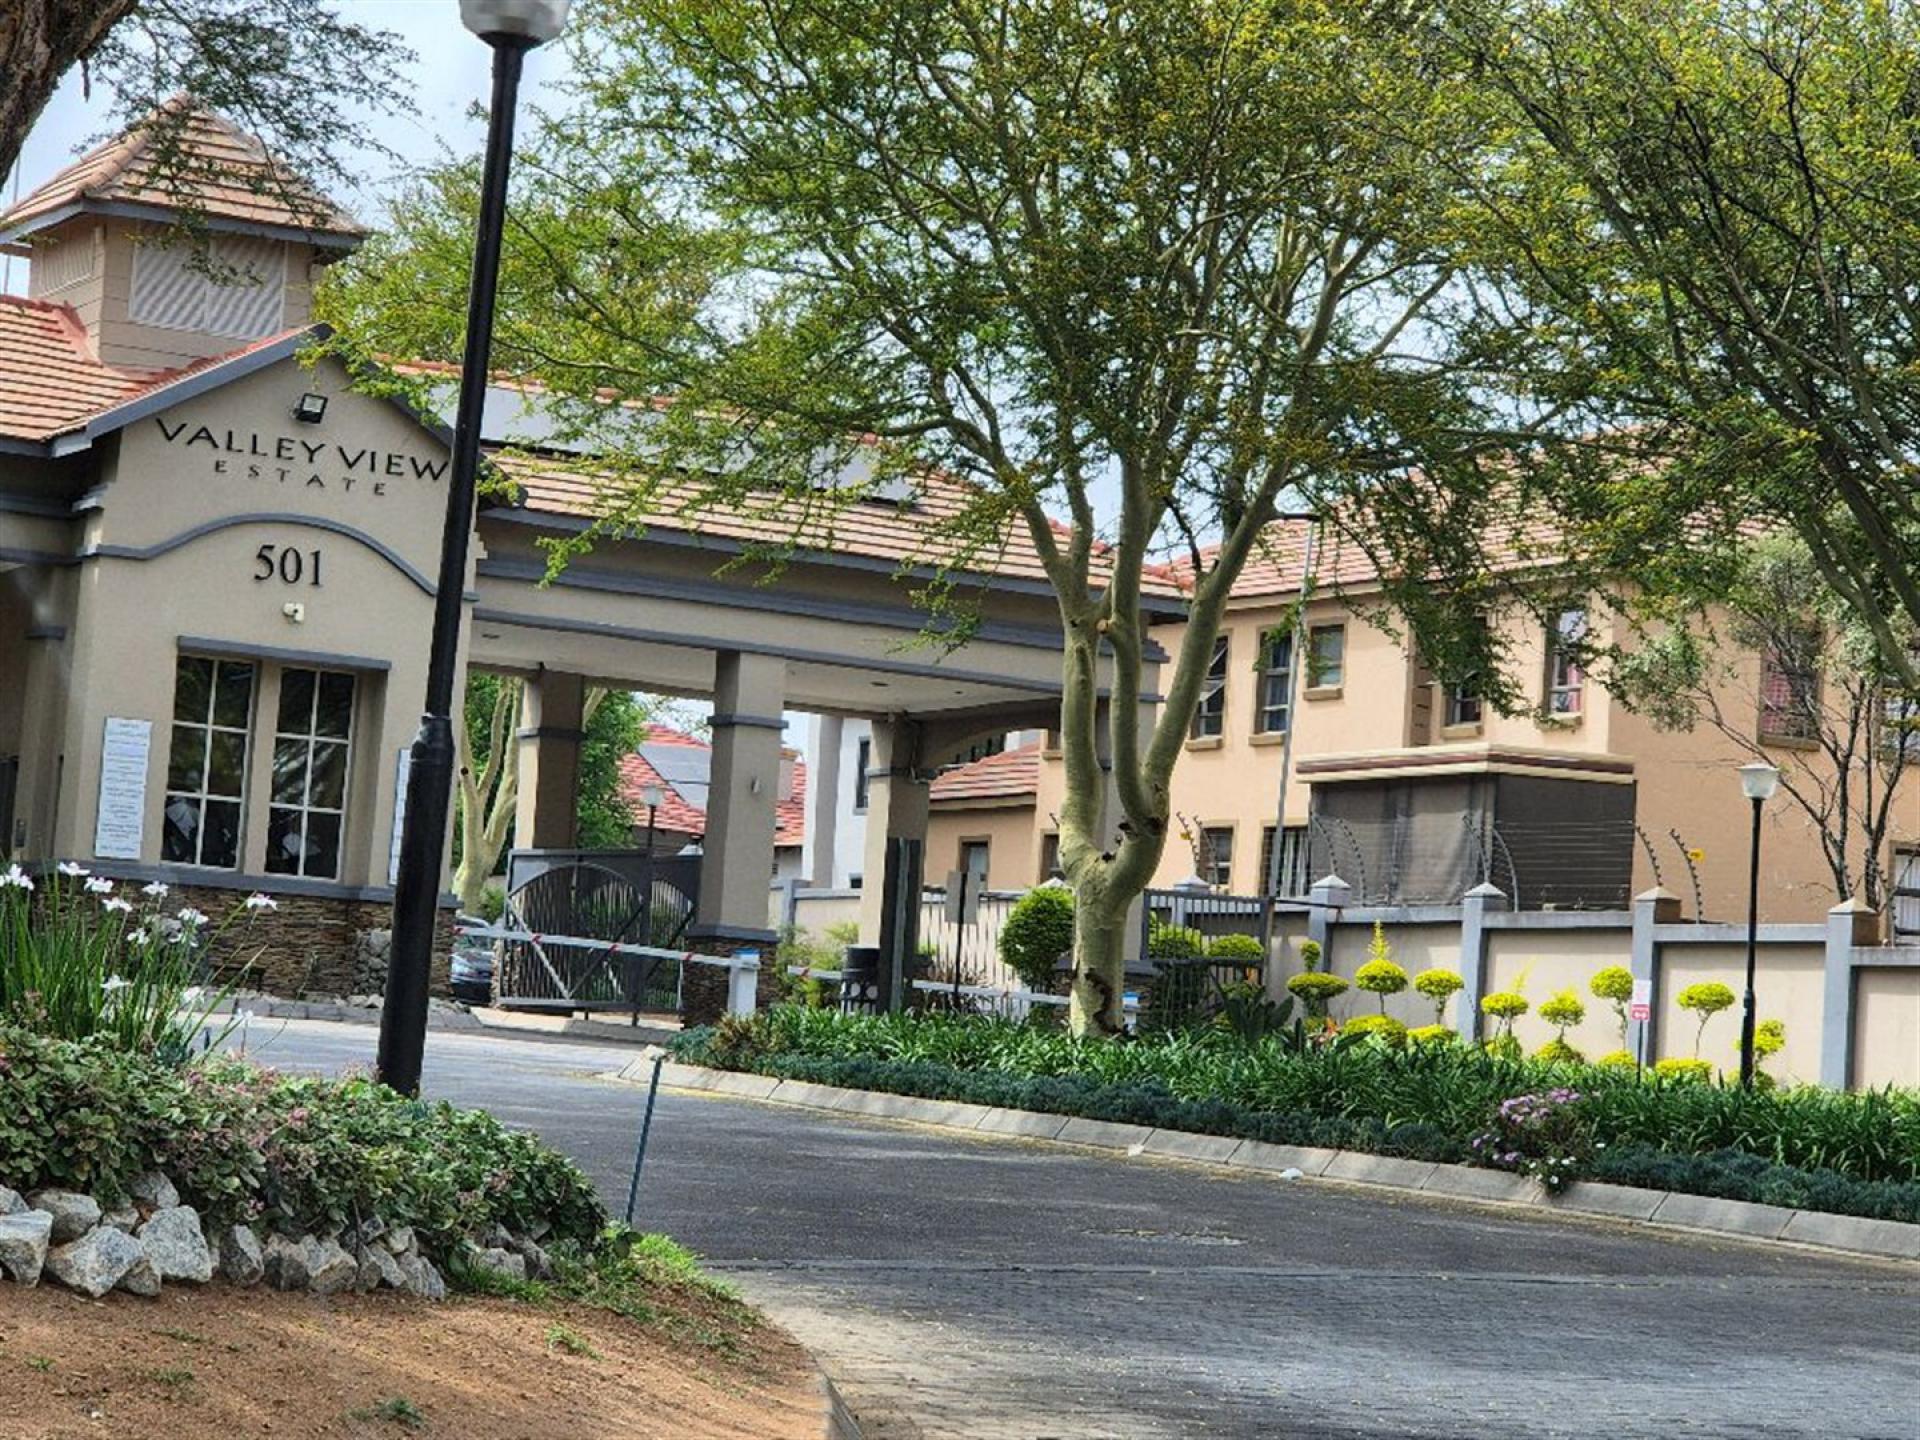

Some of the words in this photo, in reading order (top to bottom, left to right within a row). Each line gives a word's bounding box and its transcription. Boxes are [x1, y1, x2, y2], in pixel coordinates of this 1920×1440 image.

[156, 418, 326, 463] VALLEY
[337, 445, 449, 480] VIEW
[215, 460, 386, 496] ESTATE
[254, 544, 324, 586] 501
